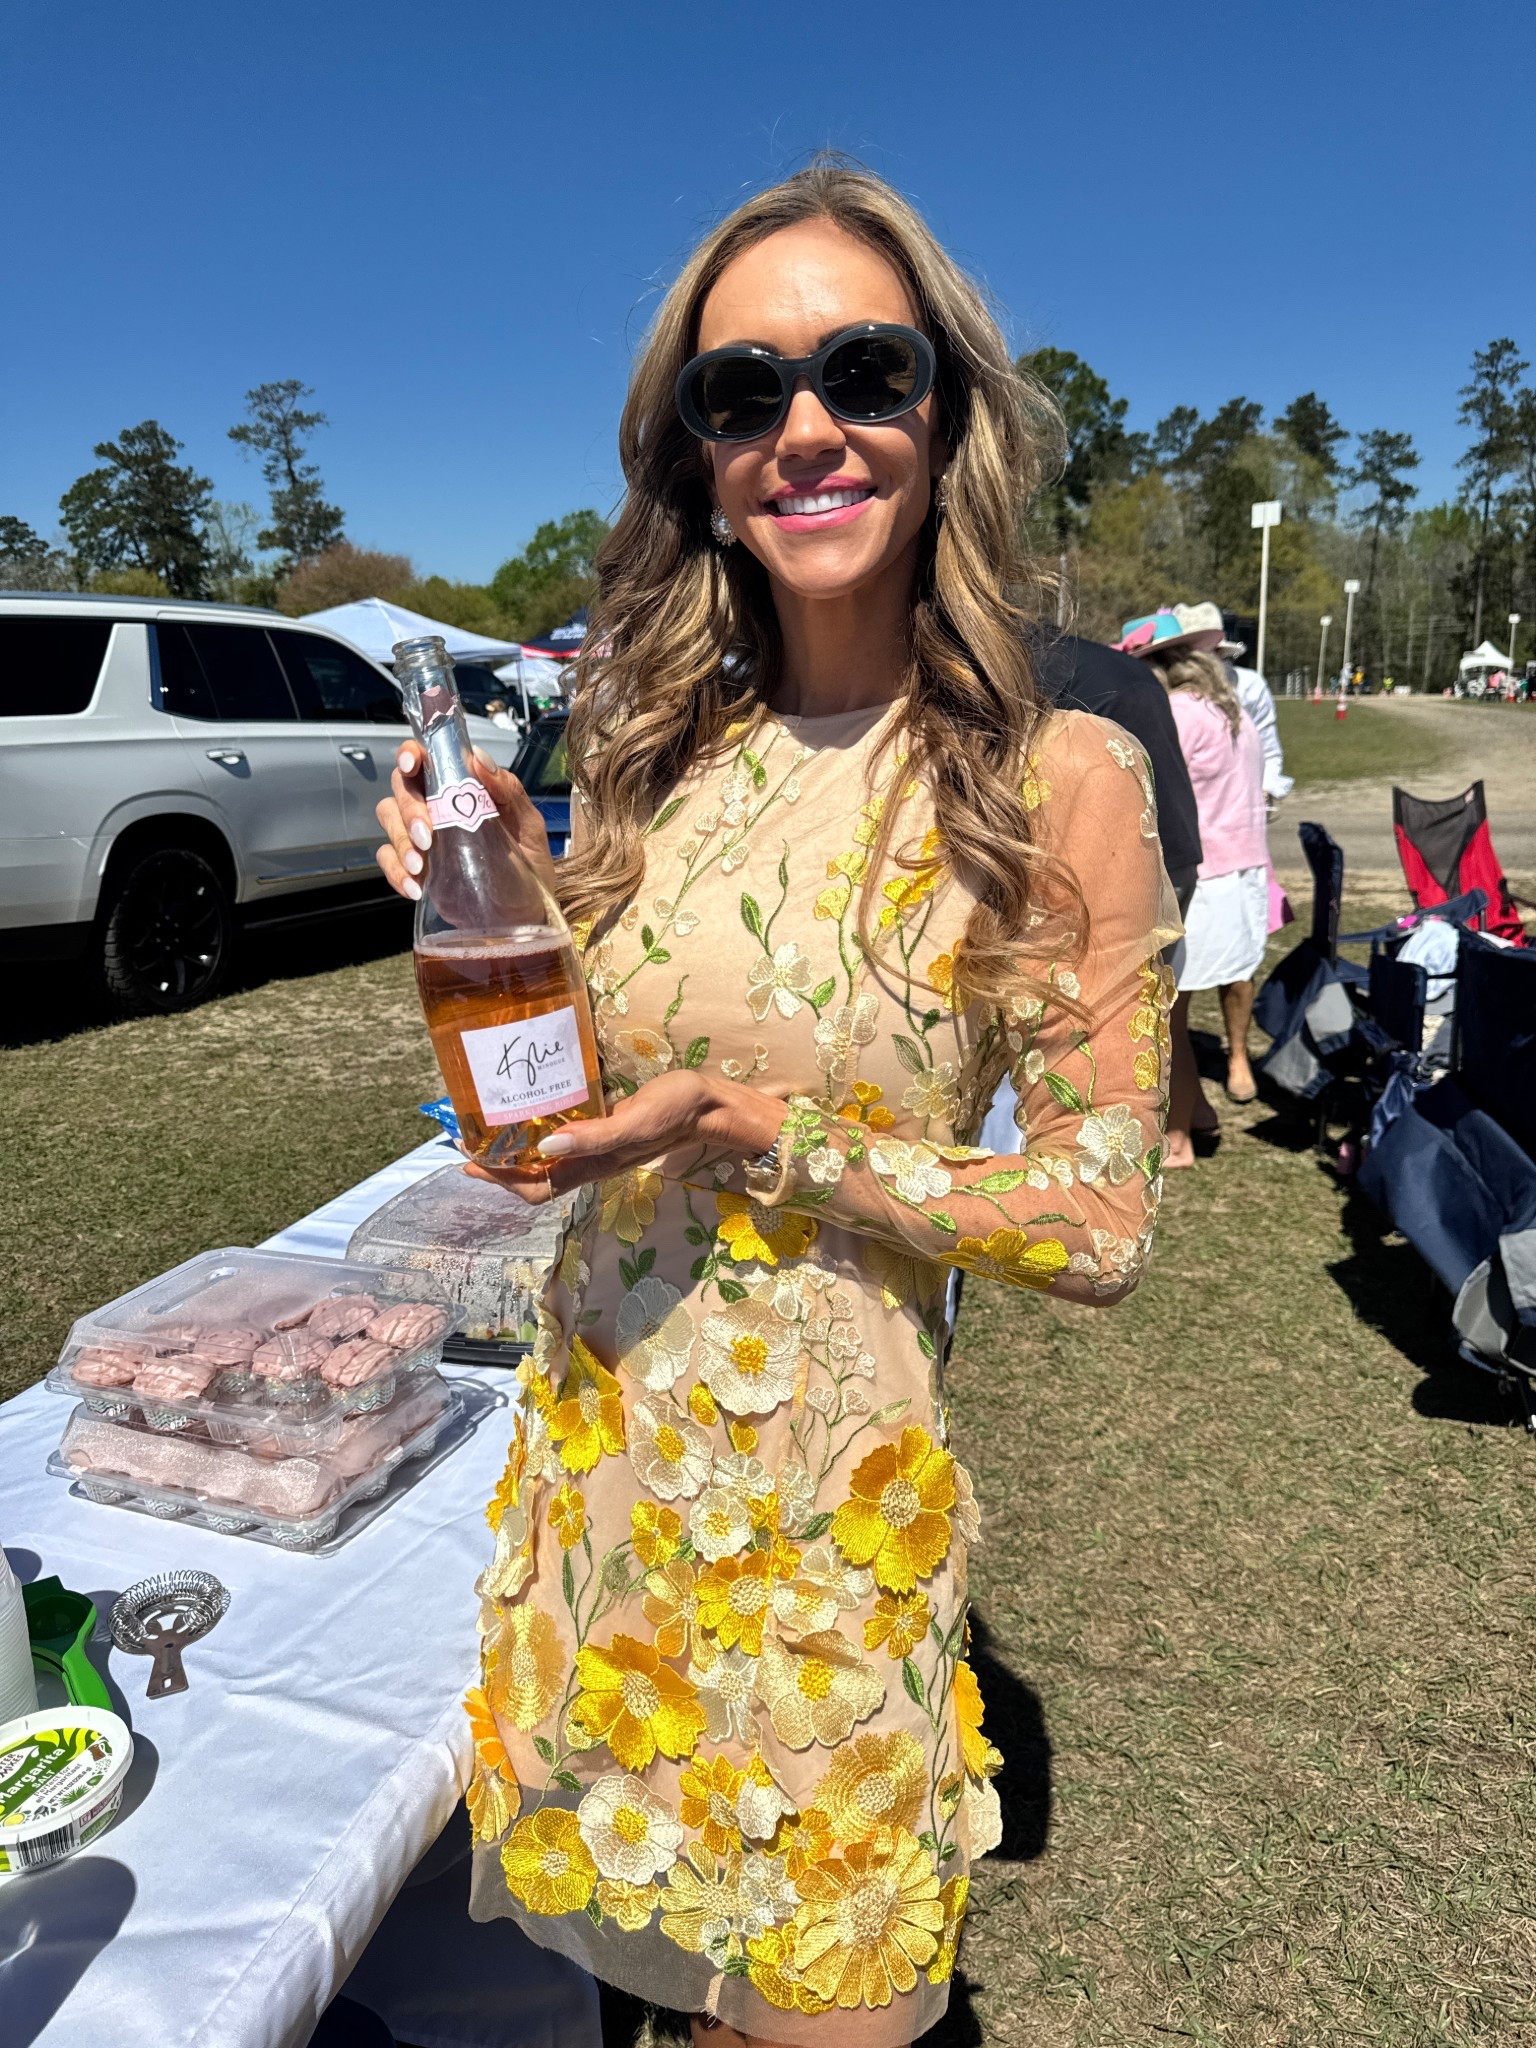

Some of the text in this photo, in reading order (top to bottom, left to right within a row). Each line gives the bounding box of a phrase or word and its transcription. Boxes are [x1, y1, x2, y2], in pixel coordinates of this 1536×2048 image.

[496, 1036, 564, 1086] Kylie
[538, 1058, 566, 1070] MINOGUE
[501, 1079, 572, 1104] ALCOHOL FREE
[504, 1103, 552, 1119] SPARKLING
[0, 1755, 23, 1778] MIXES
[0, 1748, 65, 1803] Margarita
[32, 1769, 55, 1788] SALT
[43, 1763, 82, 1795] Margaritas!
[34, 1767, 70, 1796] Perfect for
